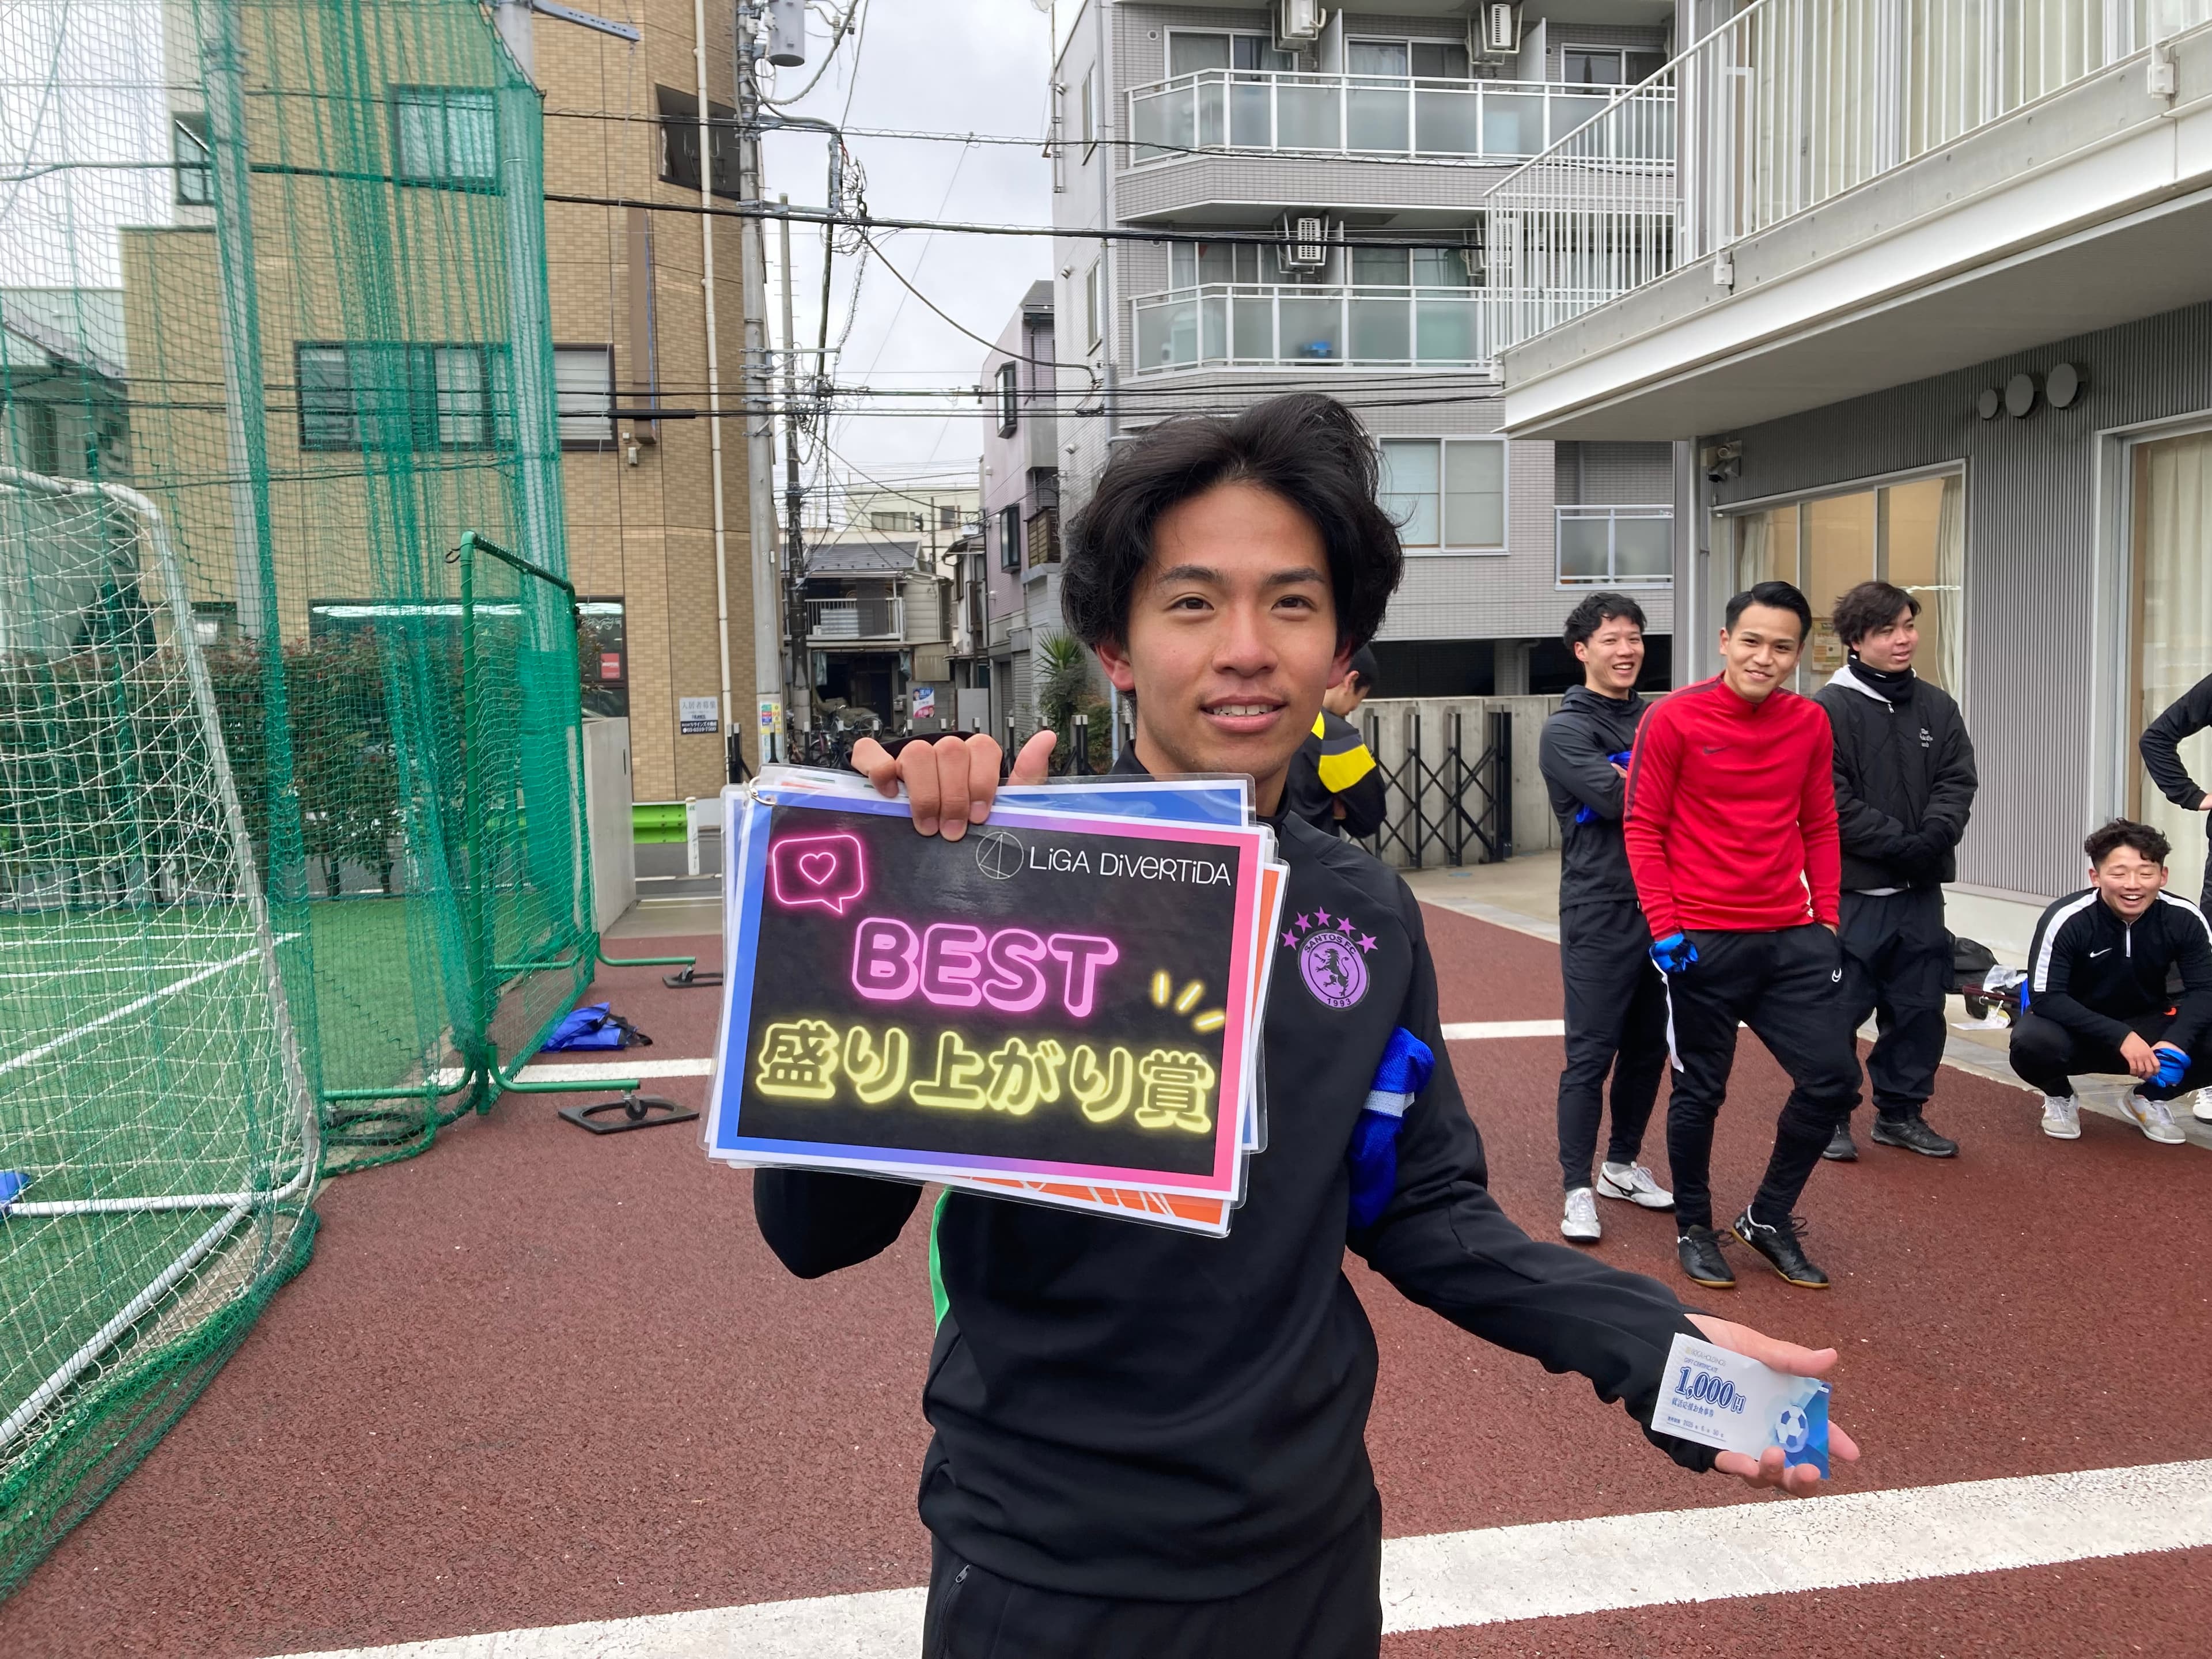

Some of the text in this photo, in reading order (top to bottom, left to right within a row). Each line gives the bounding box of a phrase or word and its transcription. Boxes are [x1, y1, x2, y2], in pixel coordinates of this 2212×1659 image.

[682, 700, 716, 710] 入居者募集
[1304, 934, 1357, 955] SANTOS FC
[852, 917, 1117, 1017] BEST
[1327, 998, 1351, 1007] 1993
[756, 1019, 1215, 1134] 盛り上がり賞
[1693, 1361, 1718, 1373] CERTIFICATE
